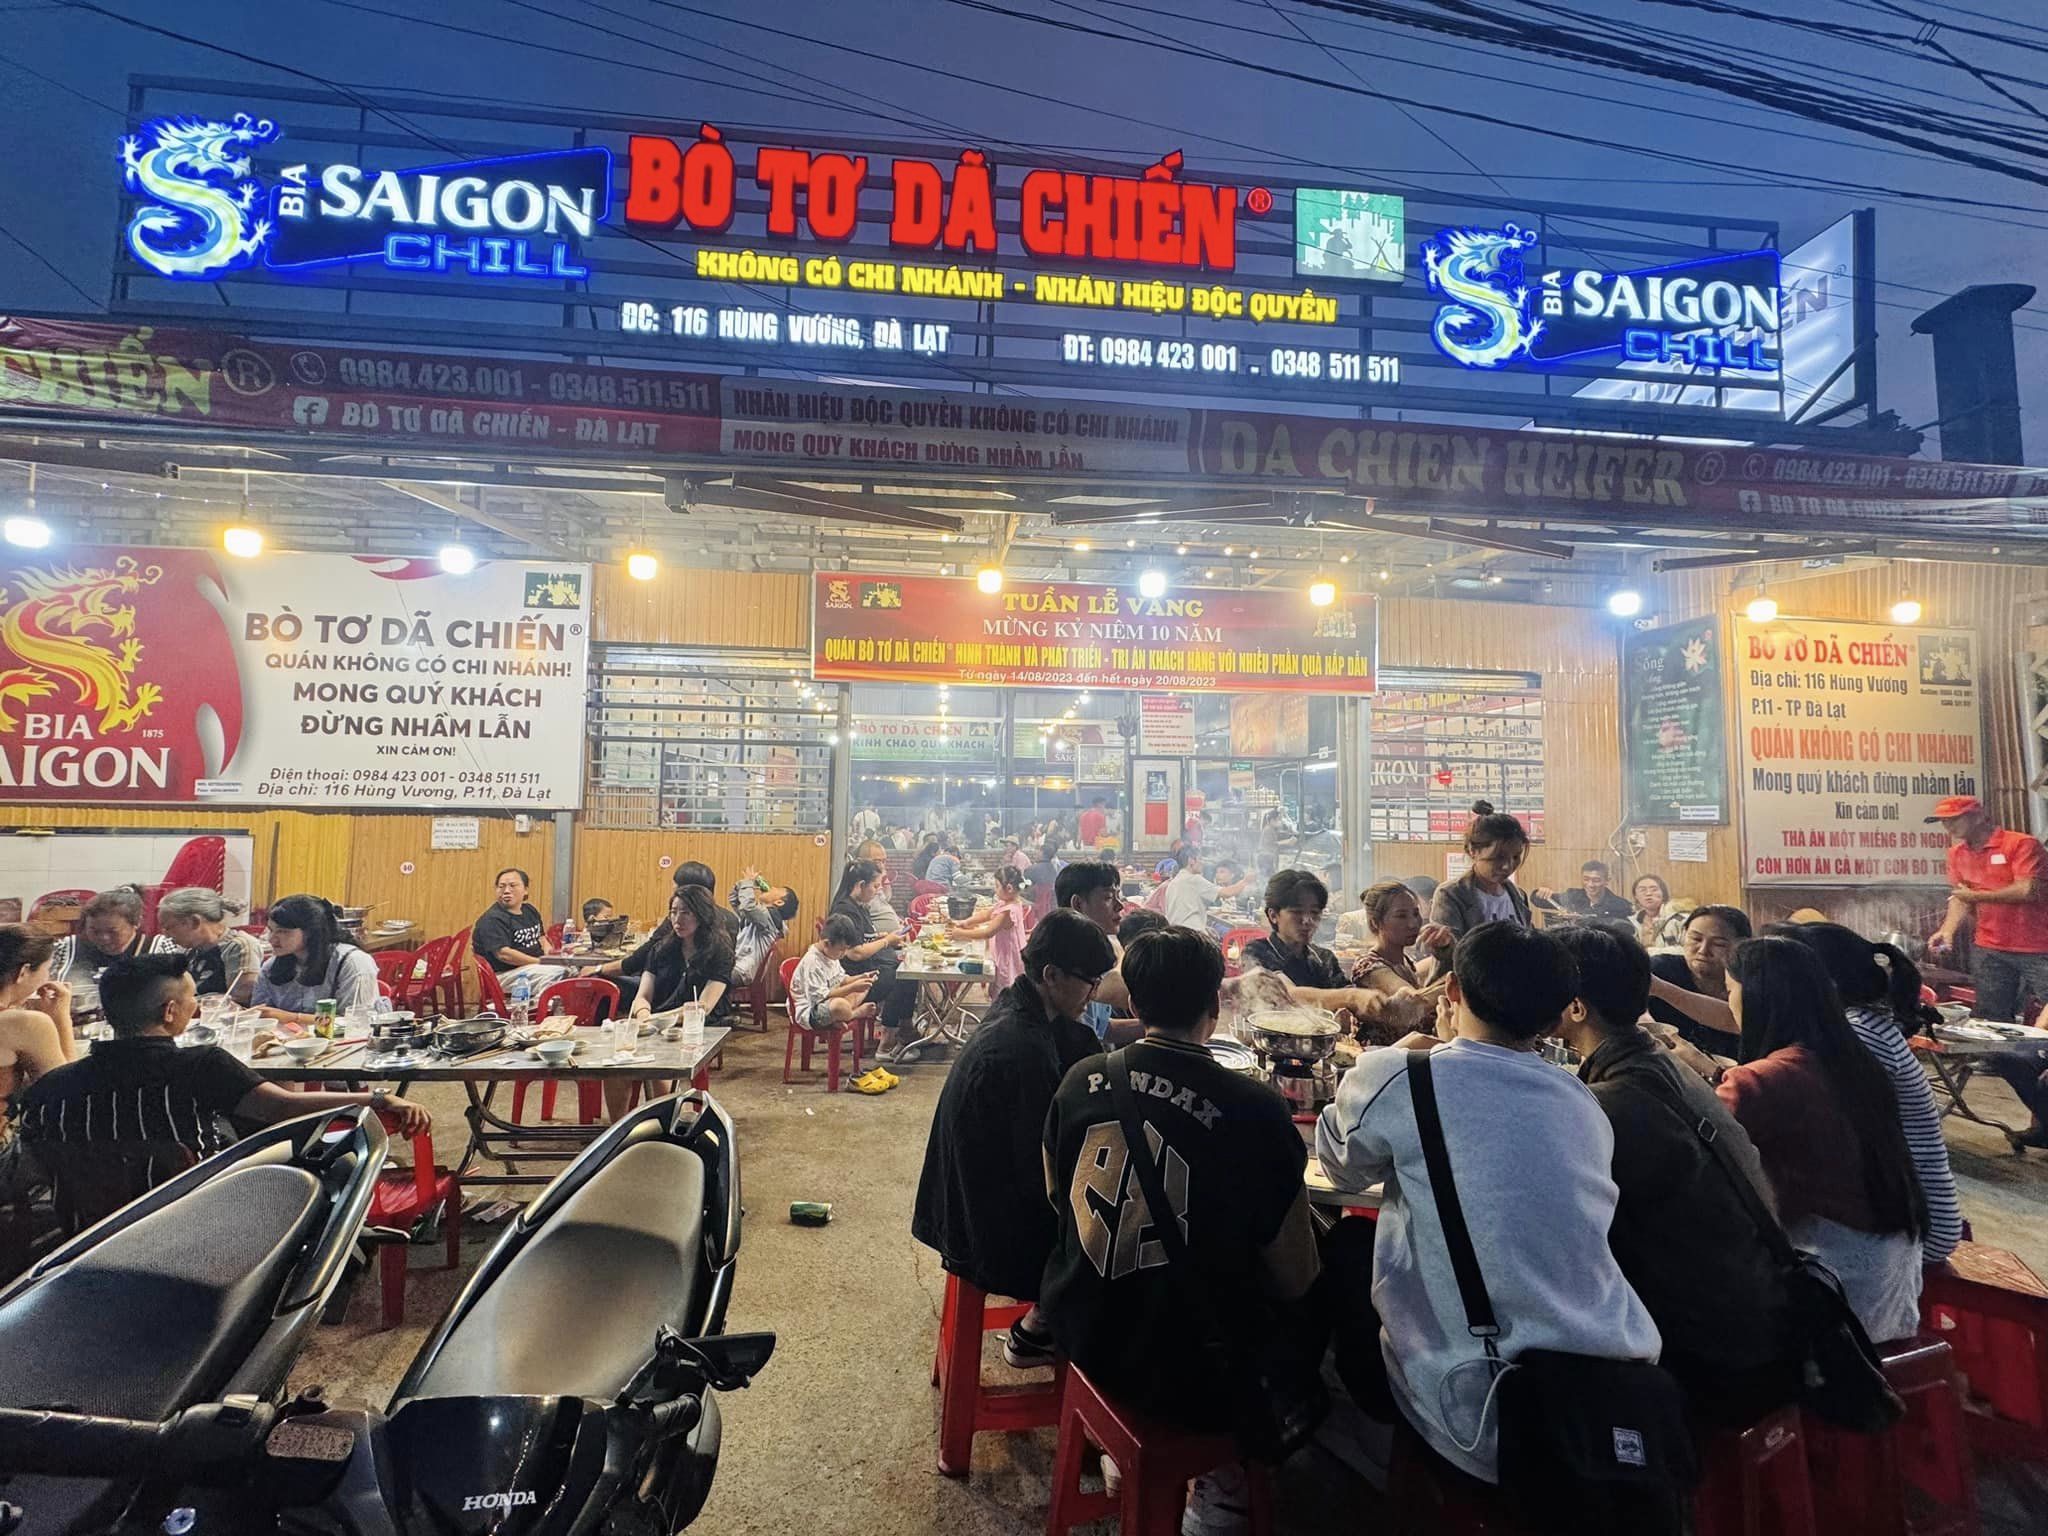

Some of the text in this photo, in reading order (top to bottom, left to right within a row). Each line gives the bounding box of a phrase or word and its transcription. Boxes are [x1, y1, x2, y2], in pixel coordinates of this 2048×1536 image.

[280, 163, 307, 217] BIA
[319, 164, 596, 237] SAIGON
[626, 123, 1237, 270] BÒ TƠ DÃ CHIẾN
[384, 231, 590, 281] CHILL
[697, 250, 799, 282] KHÔNG
[805, 255, 842, 286] CÓ
[848, 262, 896, 291] CHI
[901, 265, 1004, 298] NHÁNH
[1122, 280, 1185, 313] HIỆU
[1191, 286, 1243, 318] ĐỘC
[1250, 288, 1337, 323] QUYỀN
[1542, 270, 1562, 315] BIA
[1572, 269, 1780, 331] SAIGON
[671, 306, 709, 336] 116
[719, 307, 778, 341] HÙNG
[874, 318, 903, 350] ĐÀ
[913, 324, 950, 356] LẠT
[1064, 334, 1400, 383] ĐT: 0984 423 001 0348 511 511
[1622, 326, 1779, 371] CHILL
[339, 357, 710, 410] 0984.423.001 0348.511.511
[969, 404, 1037, 434] KHÔNG
[1043, 408, 1069, 436] CÓ
[1075, 413, 1109, 438] CHI
[733, 429, 795, 453] MONG
[850, 437, 919, 460] KHÁCH
[1504, 440, 1689, 506] HEIFER
[245, 606, 565, 651] BÒ TƠ DÃ CHIẾN
[983, 615, 1223, 643] MỪNG KỶ NIỆM 10 NĂM
[265, 650, 572, 678] QUÁN KHÔNG CÓ CHI NHÁNH!
[825, 635, 856, 663] QUÁN
[858, 637, 874, 662] BÒ
[1814, 634, 1843, 664] DÃ
[977, 671, 1007, 684] ngày
[1010, 670, 1073, 684] 14/08/2023
[1076, 672, 1099, 683] đến
[1102, 673, 1121, 684] hết
[1124, 675, 1152, 687] ngày
[1156, 675, 1216, 687] 20/08/2023
[1750, 670, 1772, 690] Địa
[1804, 672, 1825, 690] 116
[293, 680, 542, 708] MONG QUÝ KHÁCH
[301, 710, 531, 739] ĐỪNG NHẦM LẪN
[1752, 698, 1847, 721] P.11 TP Đà Lạt
[24, 713, 94, 740] BIA
[142, 729, 164, 739] 1875
[376, 743, 456, 757] XIN CẢM ƠN!
[1750, 721, 1794, 761] QUÁN
[1799, 725, 1854, 761] KHÔNG
[1858, 727, 1880, 762] CÓ
[1885, 731, 1911, 763] CHI
[270, 767, 541, 786] Điện thoại: 0984 423 001 0348 511 511
[1752, 767, 1792, 794] Mong
[1797, 769, 1823, 795] quý
[1826, 769, 1870, 794] khách
[257, 783, 285, 798] Địa
[323, 784, 350, 797] 116
[354, 782, 397, 800] Hùng
[401, 784, 458, 801] Vương,
[463, 786, 498, 800] P.11,
[502, 786, 523, 799] Đà
[527, 787, 551, 802] Lạt
[1835, 801, 1852, 820] Xin
[1884, 858, 1909, 875] CON
[1087, 1070, 1225, 1131] PNDAX
[462, 1490, 537, 1512] HONDA
